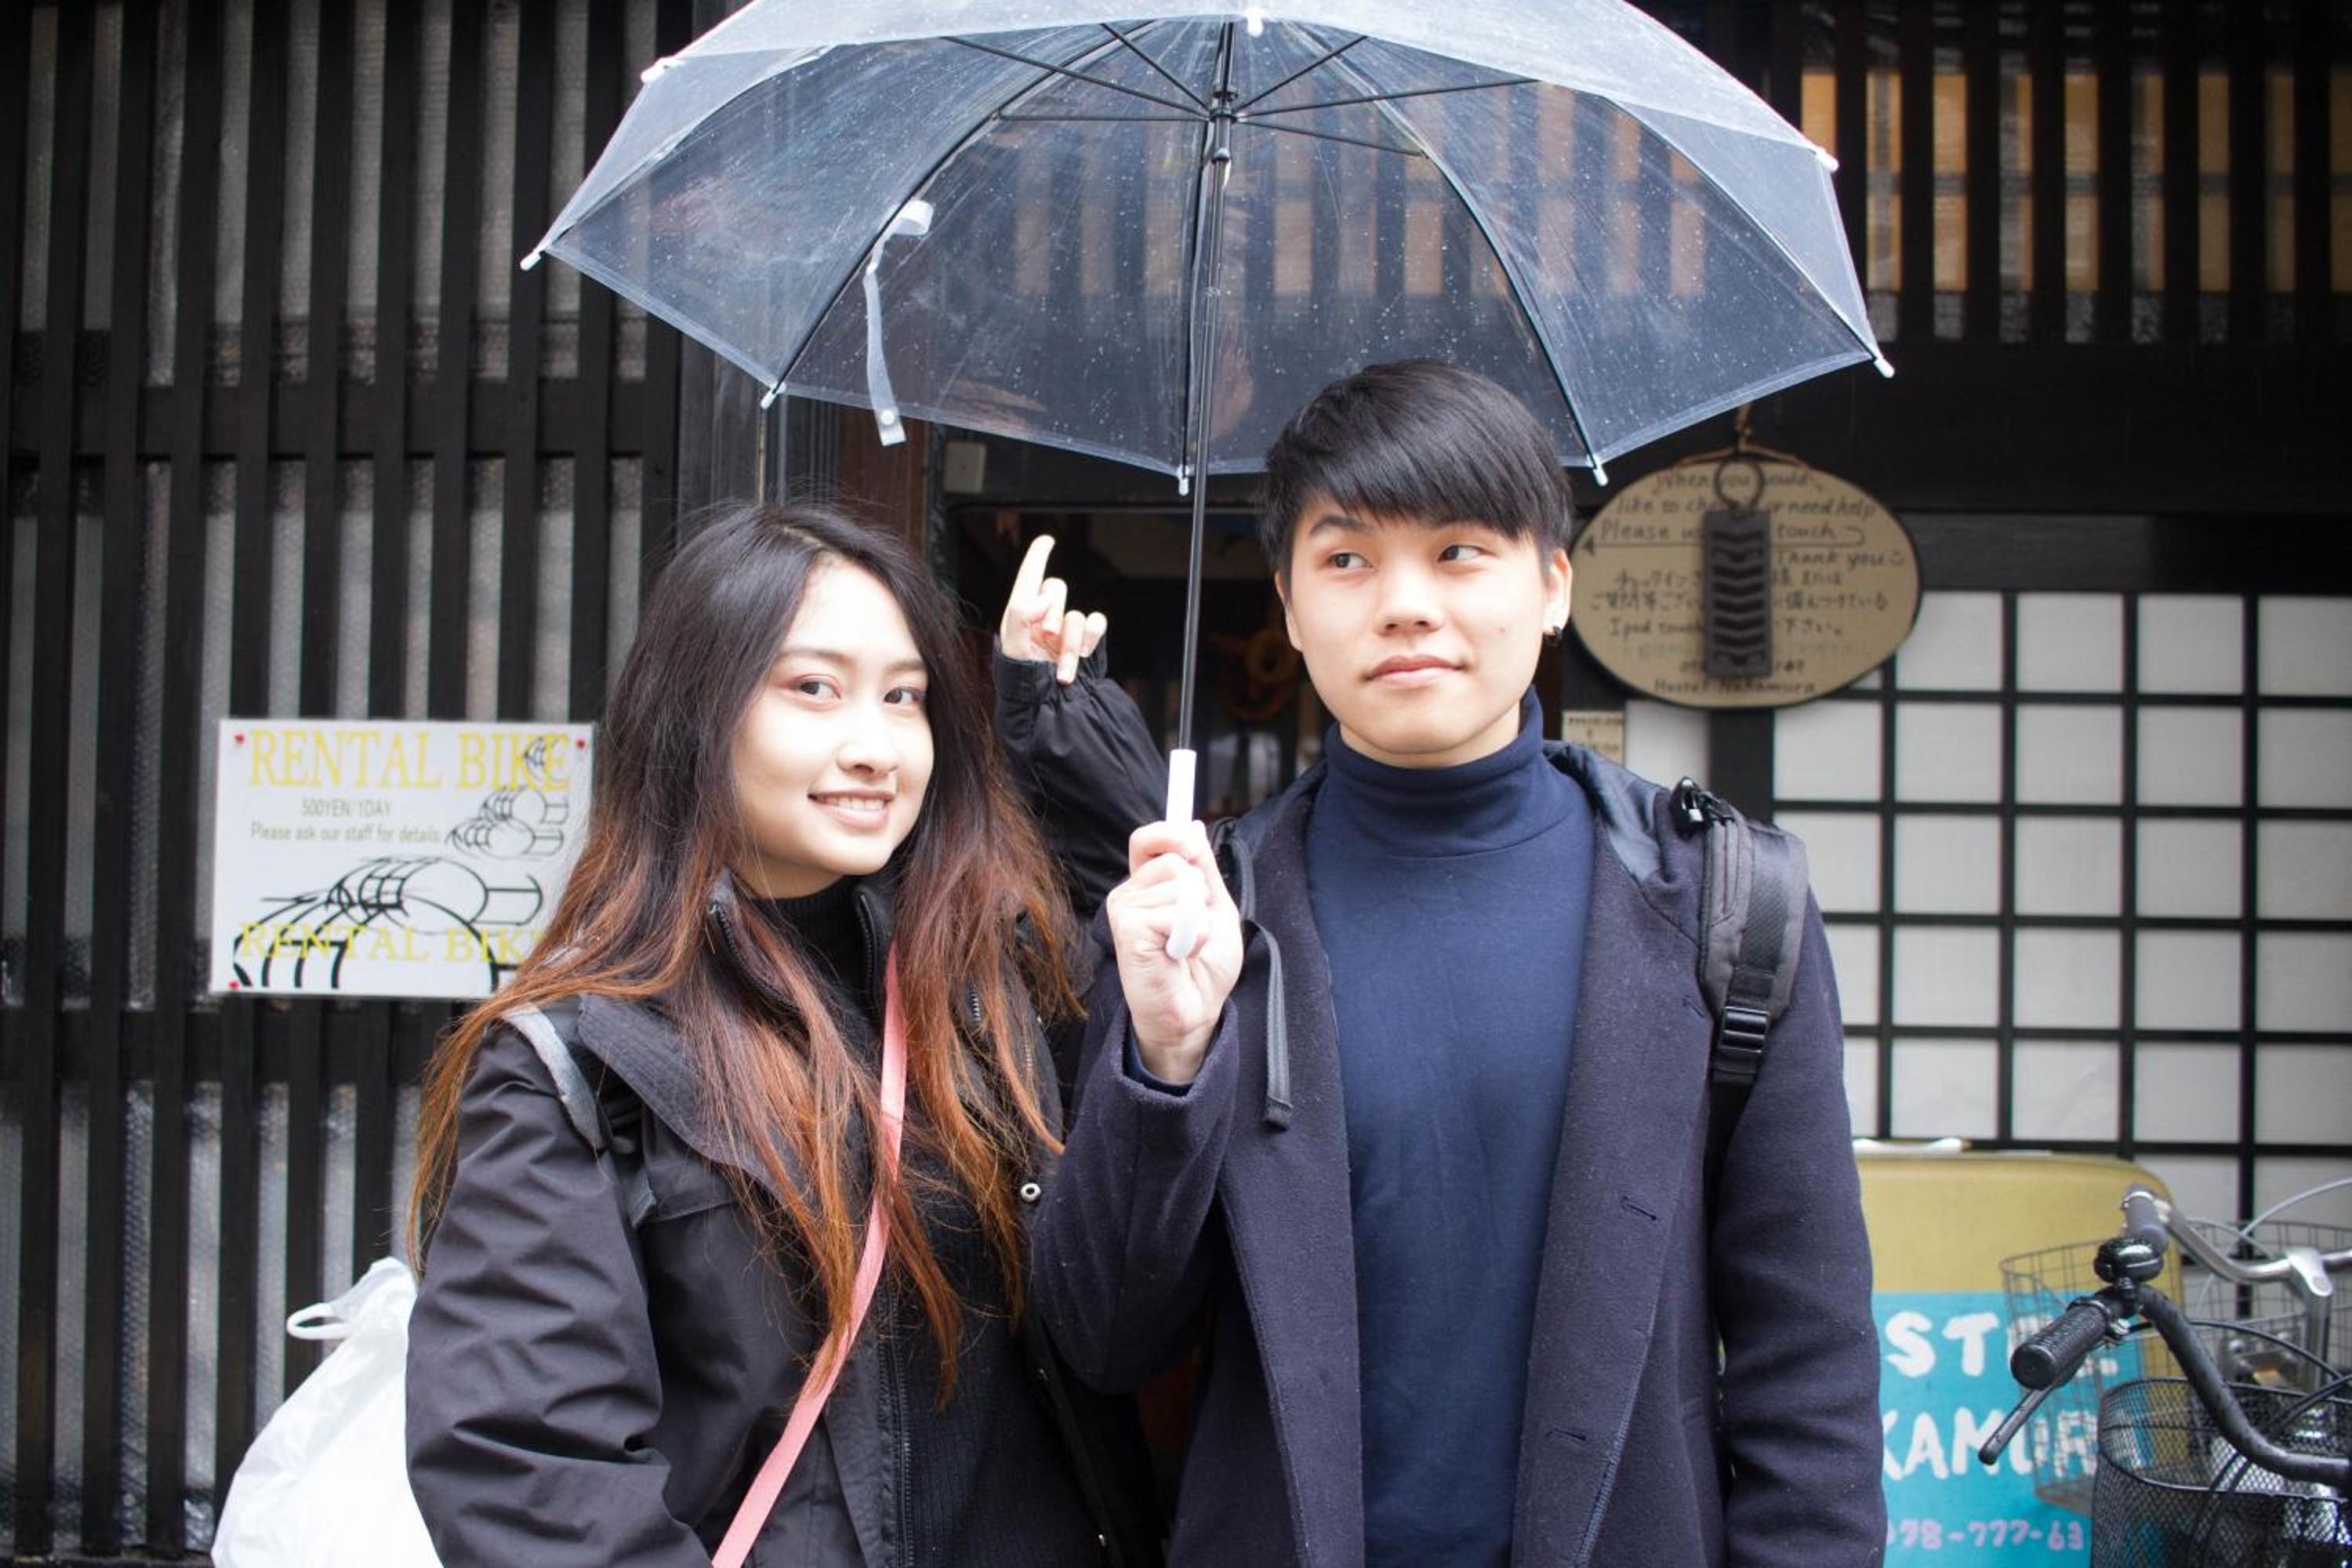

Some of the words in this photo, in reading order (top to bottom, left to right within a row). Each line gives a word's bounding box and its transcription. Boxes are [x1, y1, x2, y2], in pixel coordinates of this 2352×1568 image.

[1617, 496, 1654, 514] like
[1788, 497, 1834, 514] need
[1835, 495, 1876, 522] help
[1600, 517, 1670, 540] Please
[1776, 521, 1837, 539] touch
[1846, 550, 1884, 572] you
[249, 729, 441, 788] RENTAL
[457, 733, 571, 792] BIKE
[250, 821, 291, 841] Please
[295, 822, 314, 841] ask
[320, 827, 340, 841] our
[345, 823, 372, 842] staff
[377, 823, 393, 842] for
[240, 923, 430, 961] RENTAL
[444, 927, 543, 963] BIK
